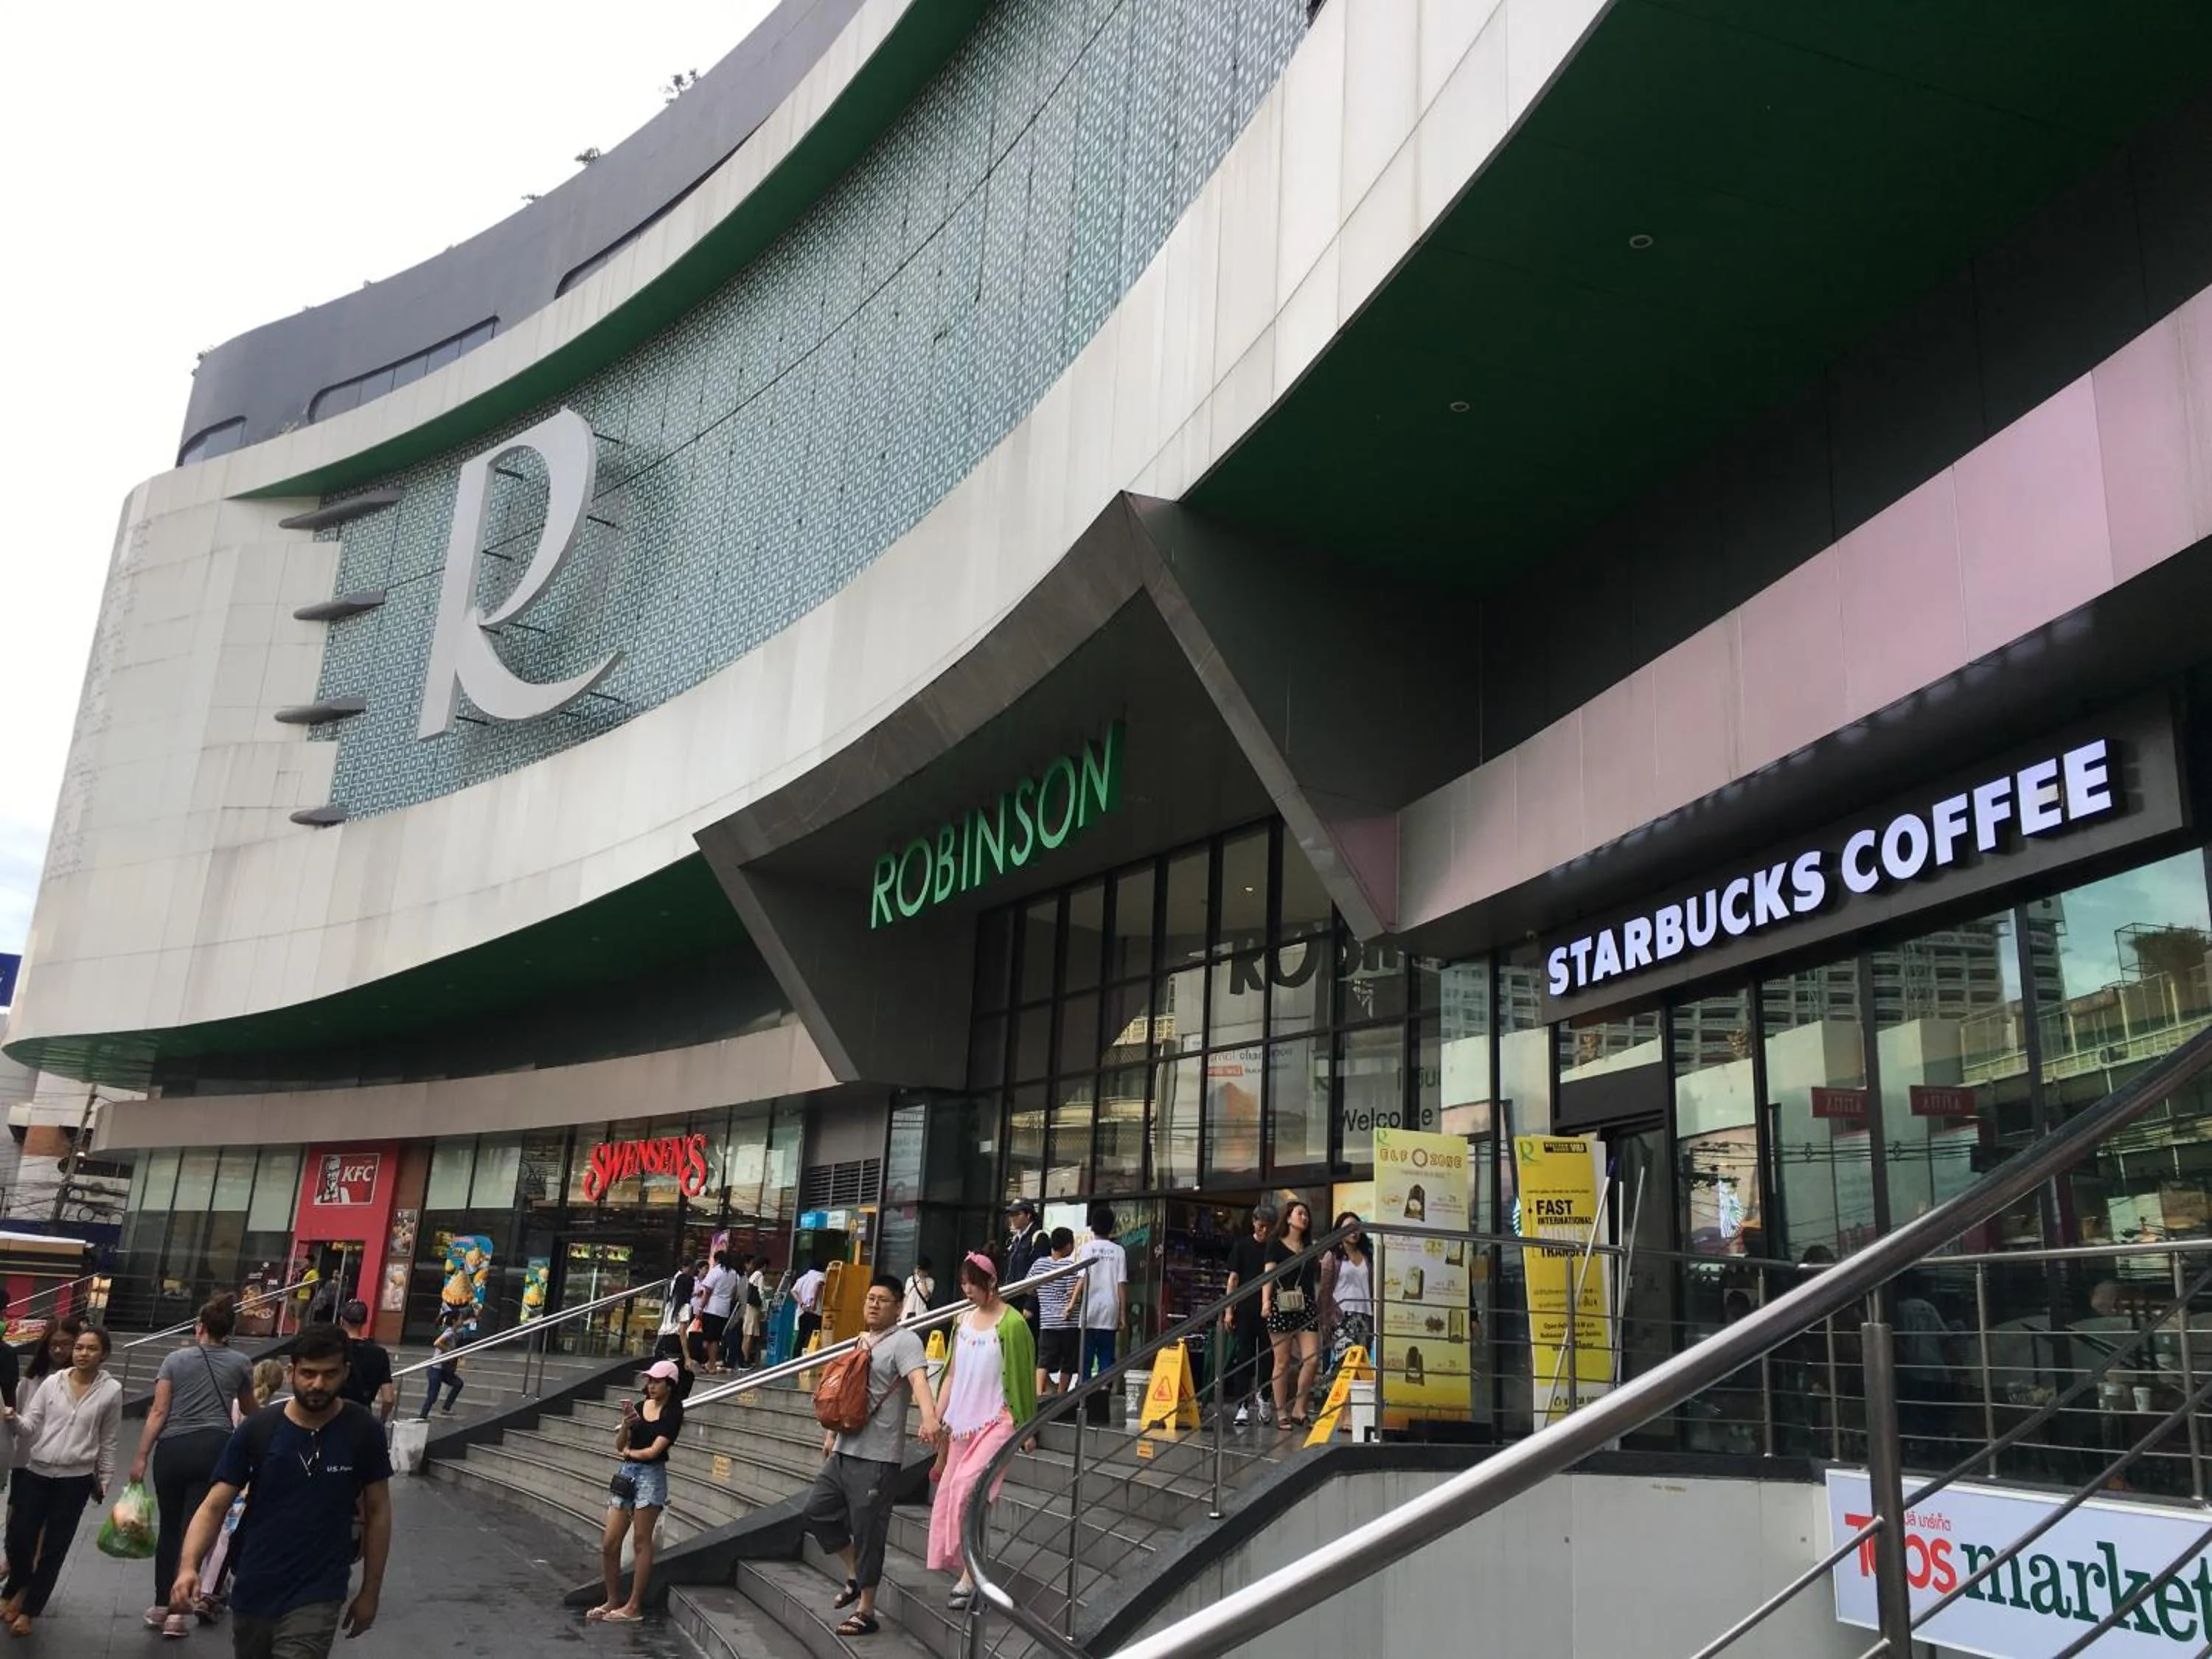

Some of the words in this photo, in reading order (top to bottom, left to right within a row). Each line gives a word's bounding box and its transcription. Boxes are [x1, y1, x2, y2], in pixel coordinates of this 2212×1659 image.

[418, 406, 625, 742] R
[871, 720, 1122, 929] ROBINSON
[1548, 849, 1826, 996] STARBUCKS
[1841, 739, 2112, 894] COFFEE
[1343, 1107, 1433, 1132] Welcoe
[341, 1165, 375, 1183] KFC
[583, 1133, 707, 1202] SWENSEN'S
[1536, 1200, 1573, 1216] FAST
[1960, 1540, 2212, 1644] market
